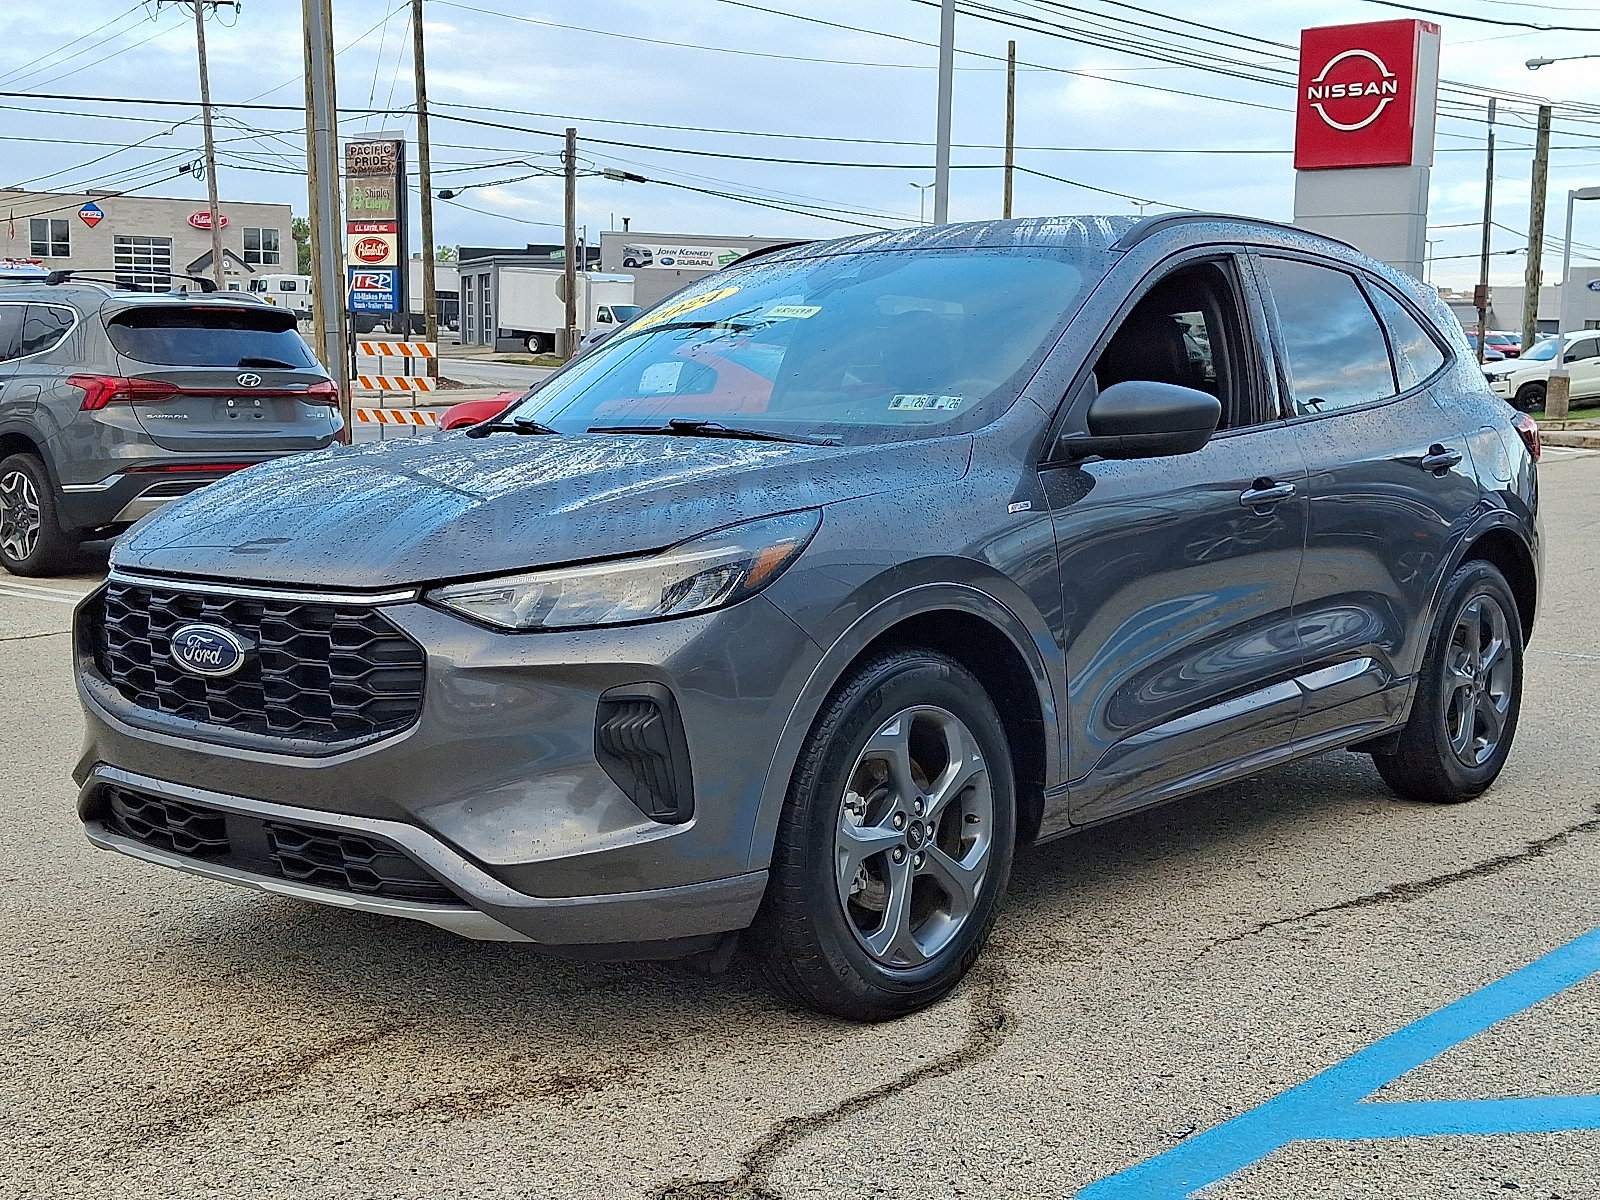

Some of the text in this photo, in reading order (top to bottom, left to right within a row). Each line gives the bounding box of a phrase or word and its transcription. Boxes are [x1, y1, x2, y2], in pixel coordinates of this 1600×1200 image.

[1307, 80, 1398, 100] NISSAN
[350, 145, 391, 156] PACIFIC
[354, 156, 387, 166] PRIDE
[364, 187, 390, 200] Shipley
[656, 247, 714, 257] JOHN KENNEDY
[677, 259, 713, 267] SUBARU
[355, 274, 391, 289] TRP
[183, 634, 223, 665] Ford
